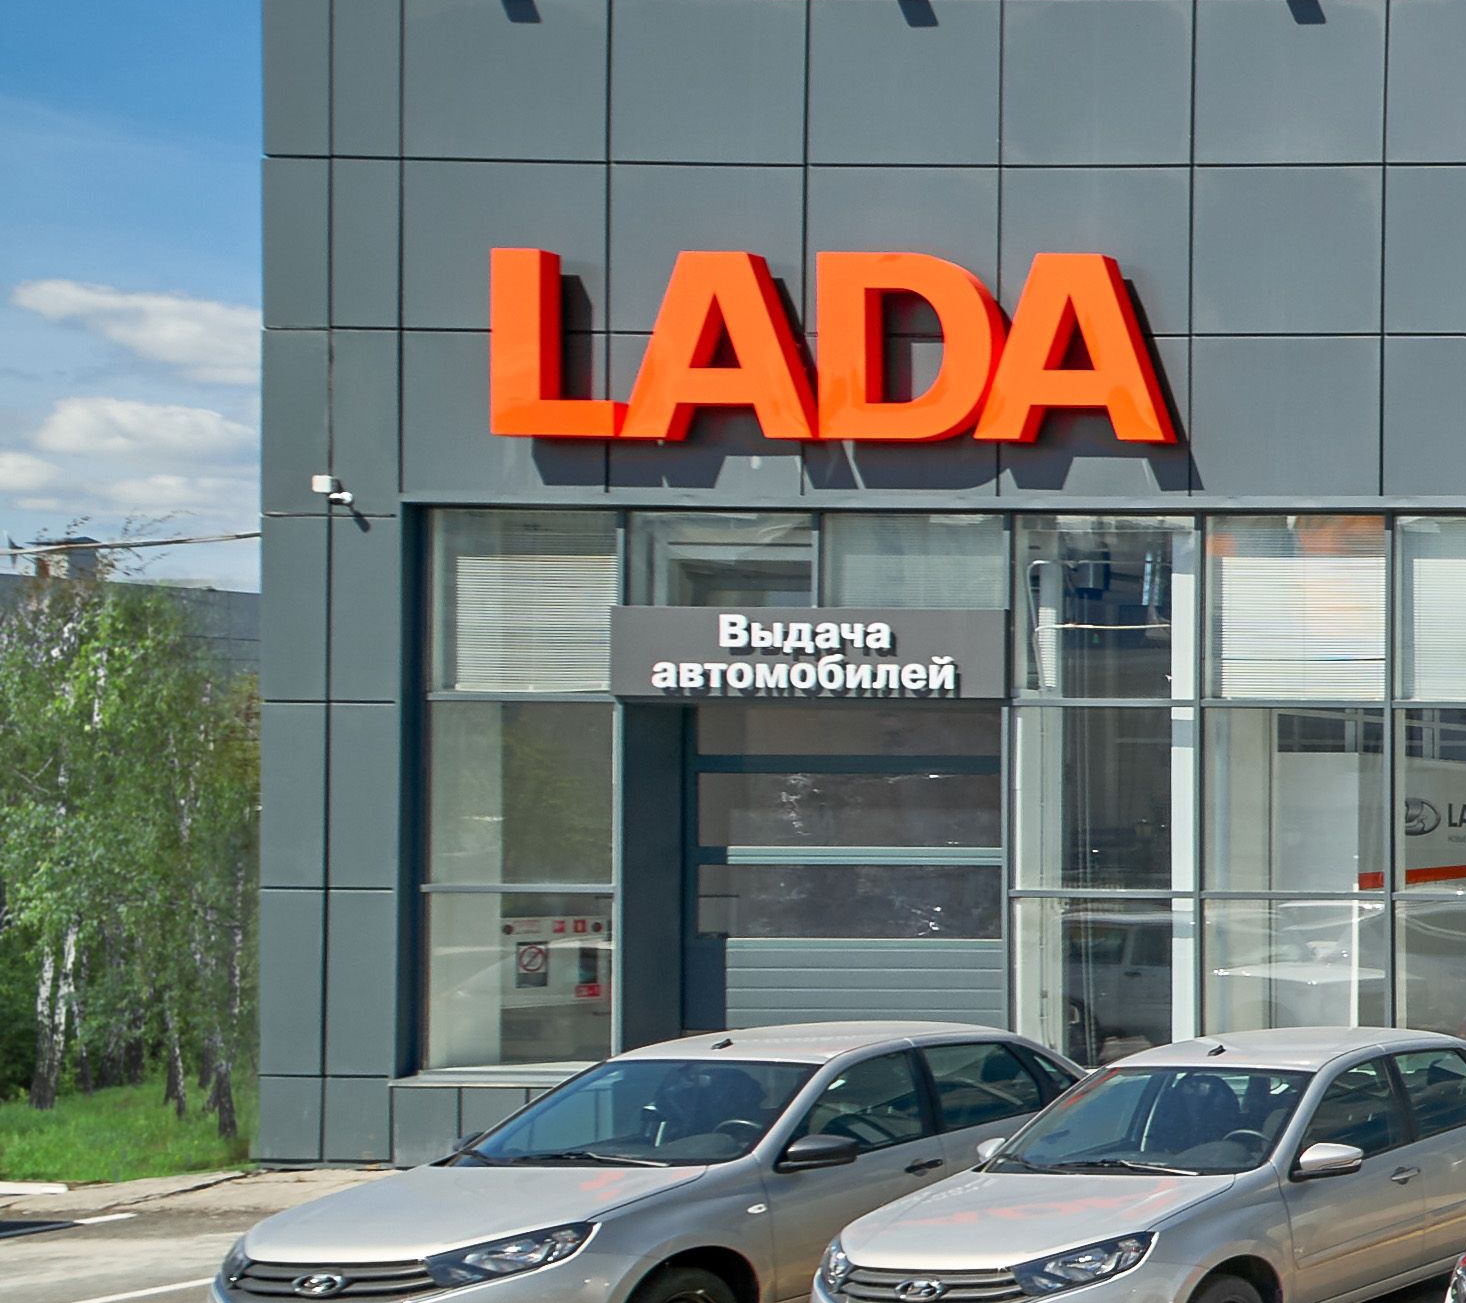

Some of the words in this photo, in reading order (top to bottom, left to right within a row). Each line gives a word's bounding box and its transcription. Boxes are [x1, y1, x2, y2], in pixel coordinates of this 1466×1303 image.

[490, 247, 1179, 444] LADA
[718, 613, 891, 654] Выдача
[651, 654, 956, 690] автомобилей
